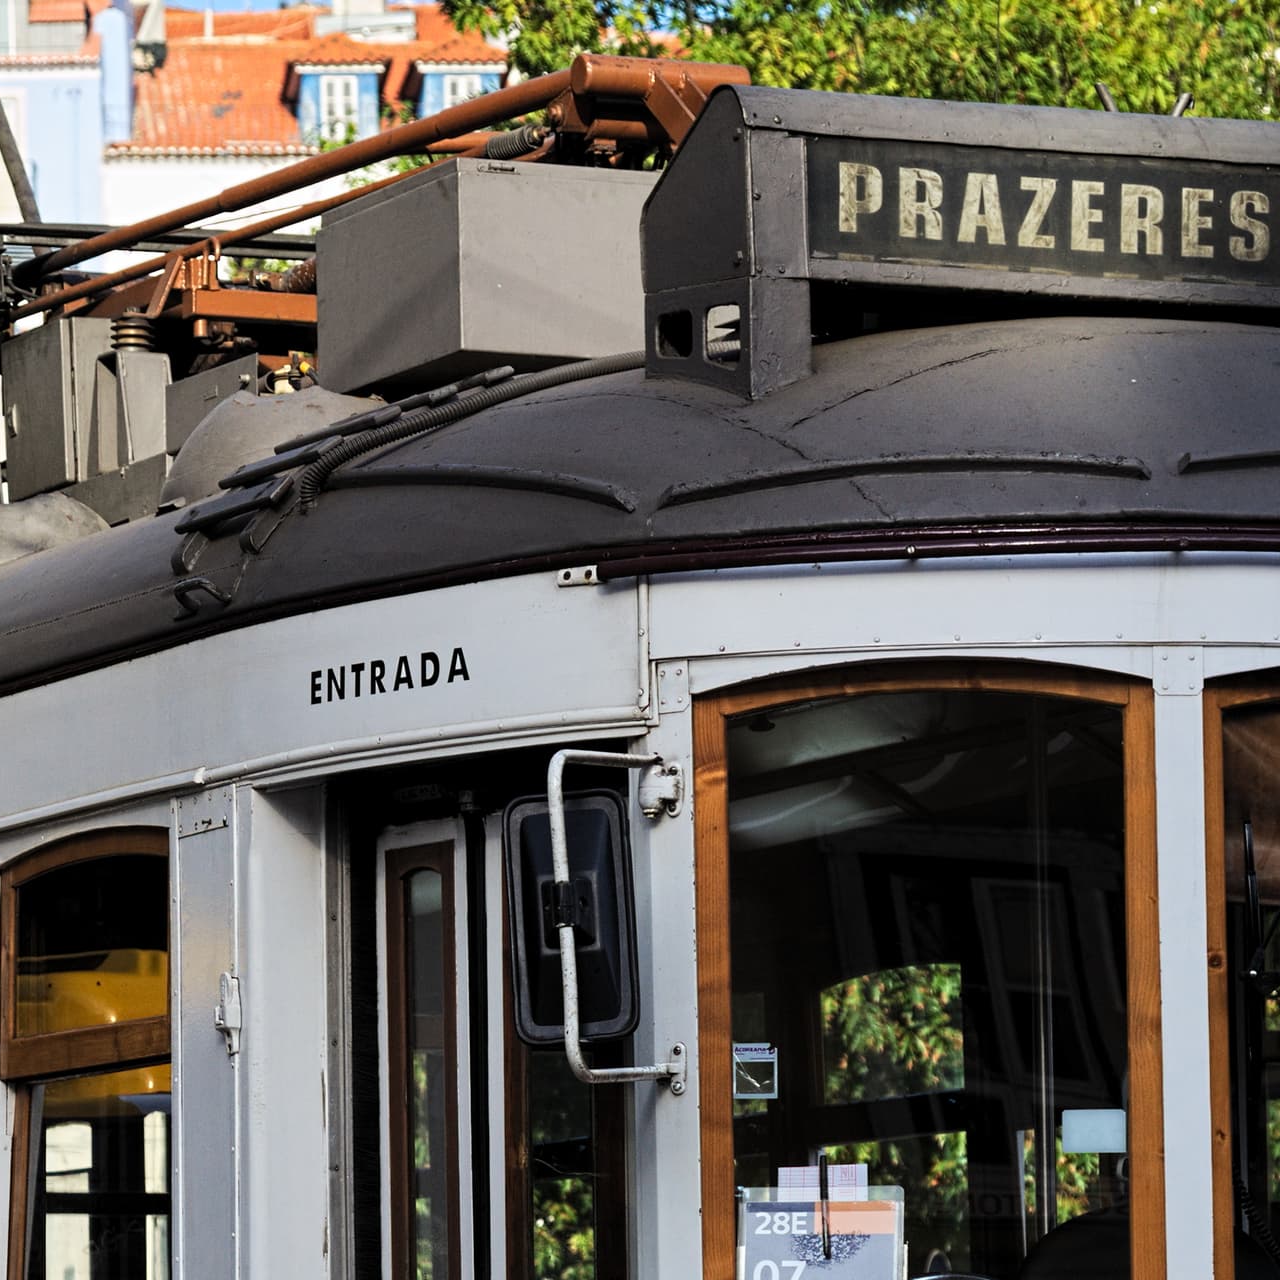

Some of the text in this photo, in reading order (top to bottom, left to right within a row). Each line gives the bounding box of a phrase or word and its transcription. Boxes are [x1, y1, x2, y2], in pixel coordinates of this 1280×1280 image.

[838, 161, 1270, 262] PRAZERES
[311, 647, 470, 705] ENTRADA
[754, 1211, 808, 1235] 28E
